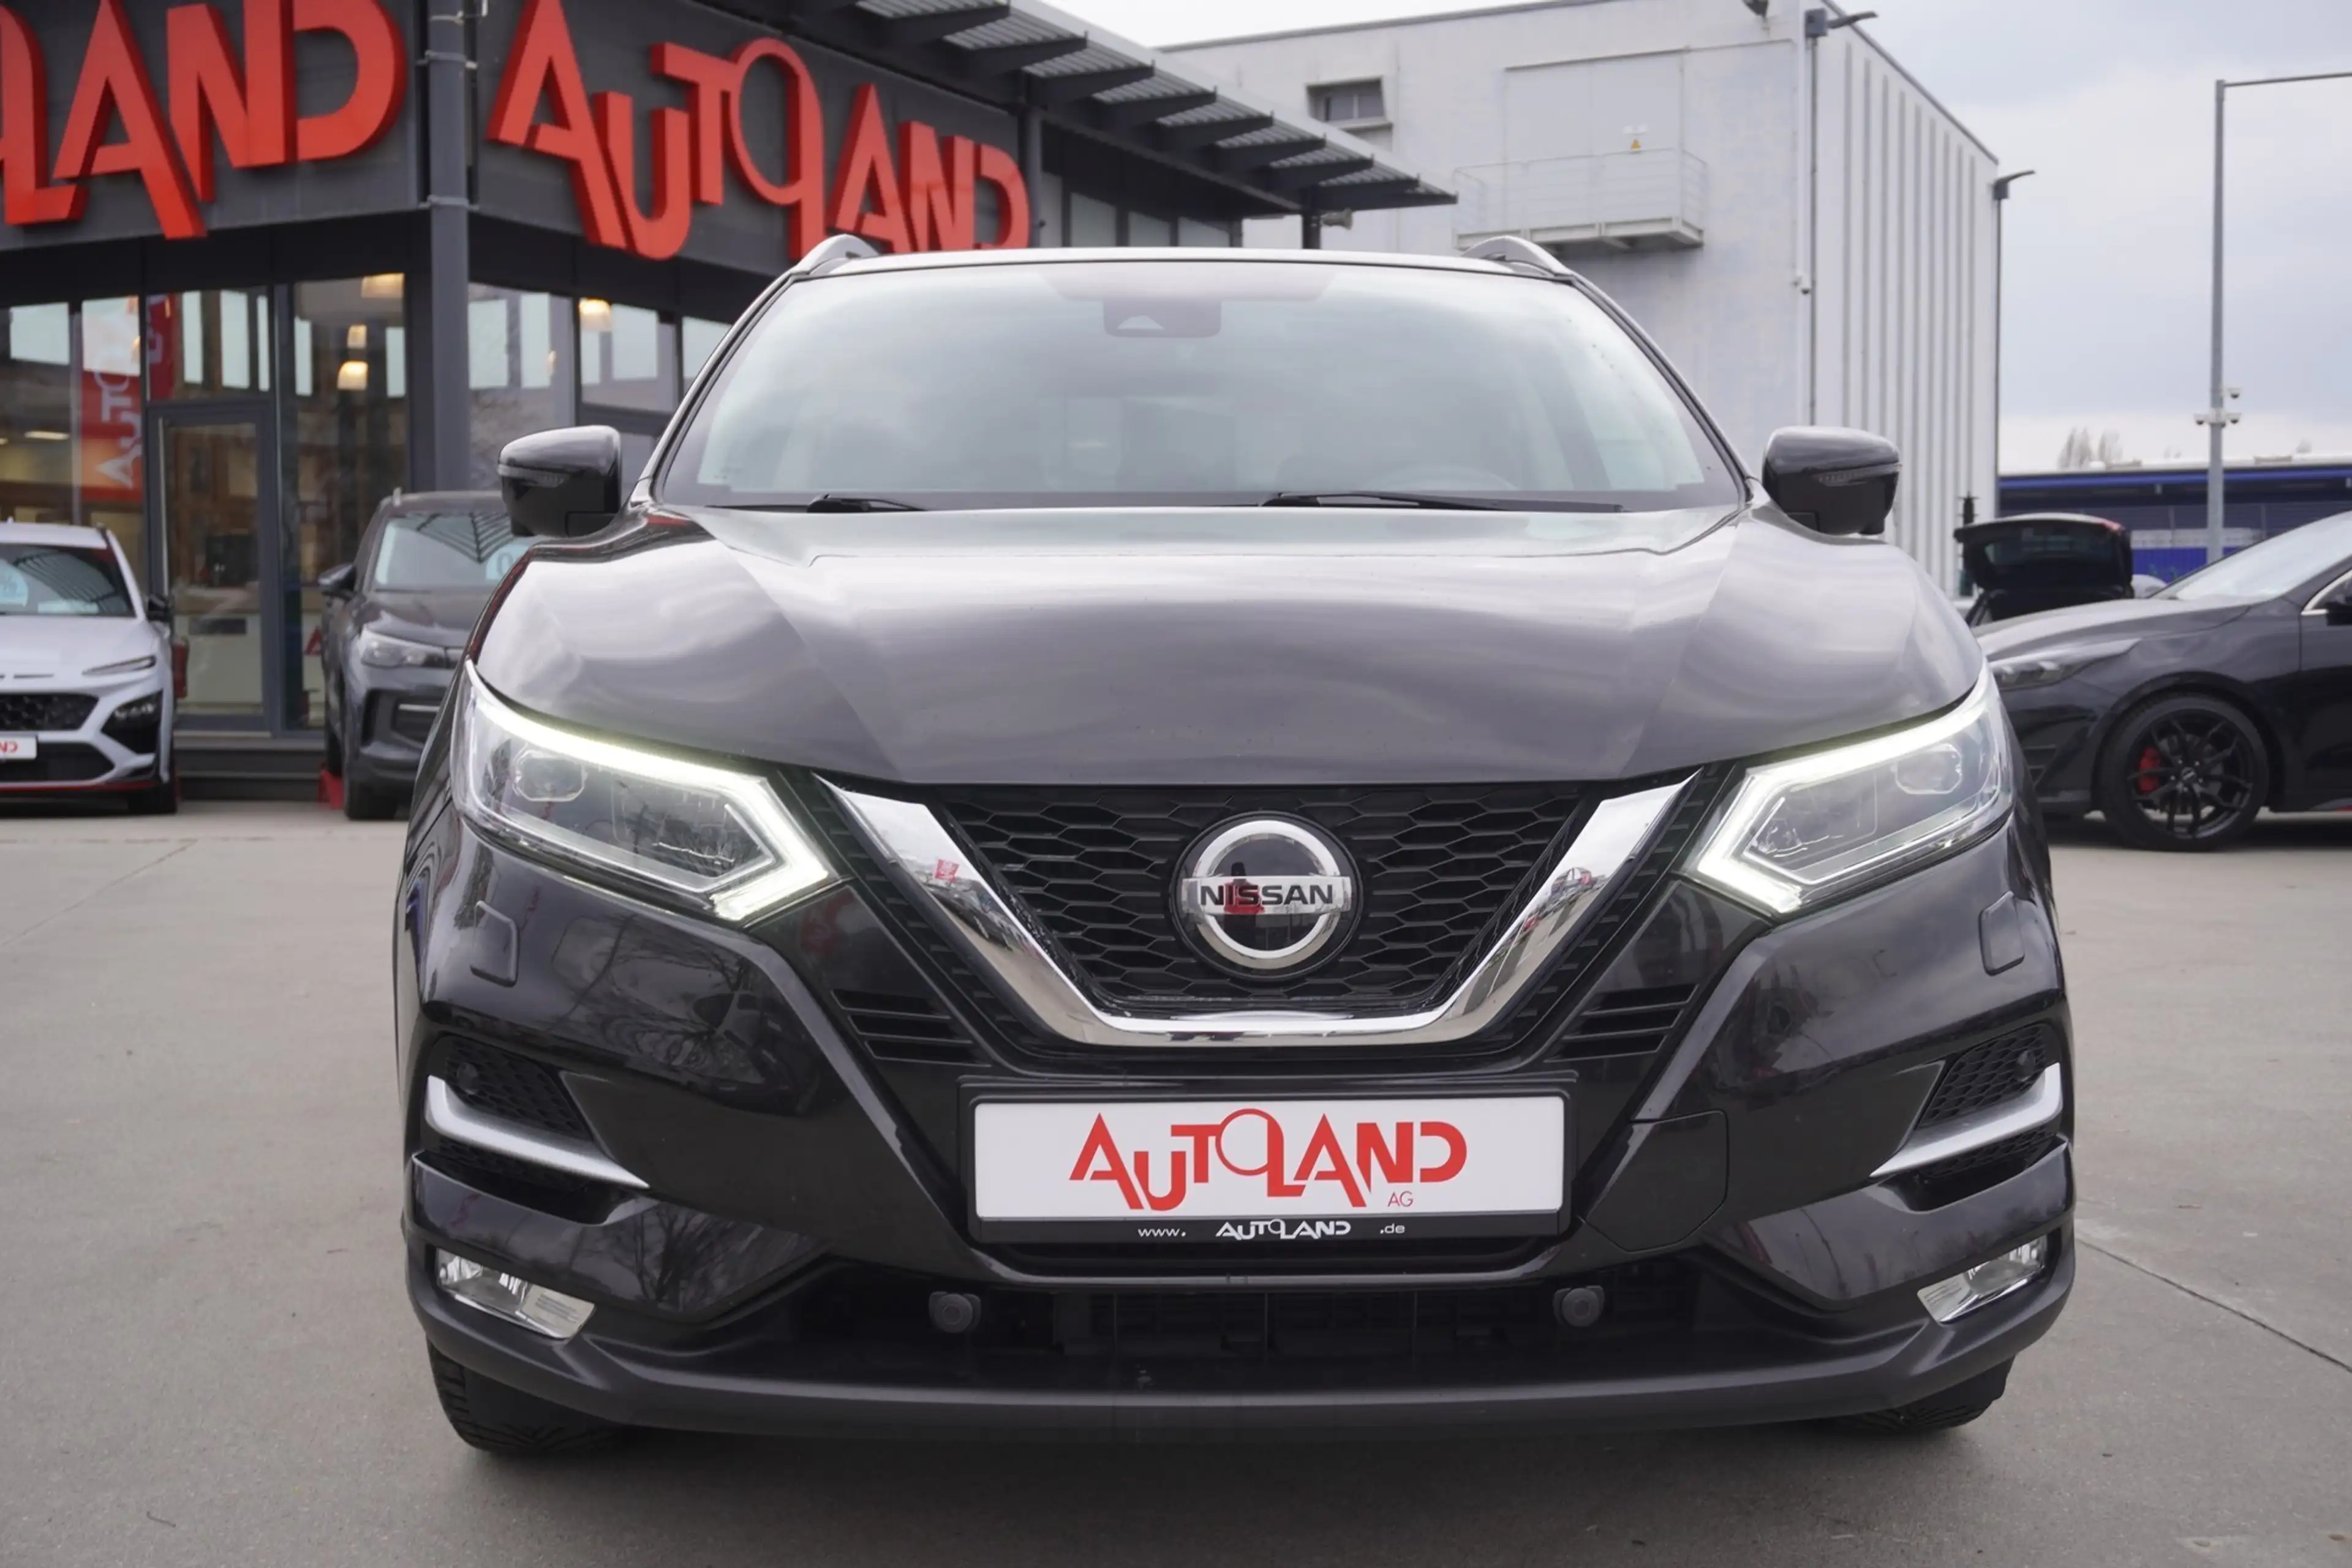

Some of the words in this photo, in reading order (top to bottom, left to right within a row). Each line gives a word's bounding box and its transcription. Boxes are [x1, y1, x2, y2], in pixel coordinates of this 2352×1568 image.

[0, 0, 409, 239] LAND
[1200, 884, 1333, 905] NISSAN
[1069, 1108, 1468, 1211] AUTOLAND
[1387, 1191, 1414, 1208] AG
[1137, 1227, 1186, 1238] www.
[1215, 1219, 1351, 1240] AUTOLAND
[1379, 1224, 1405, 1235] .de
